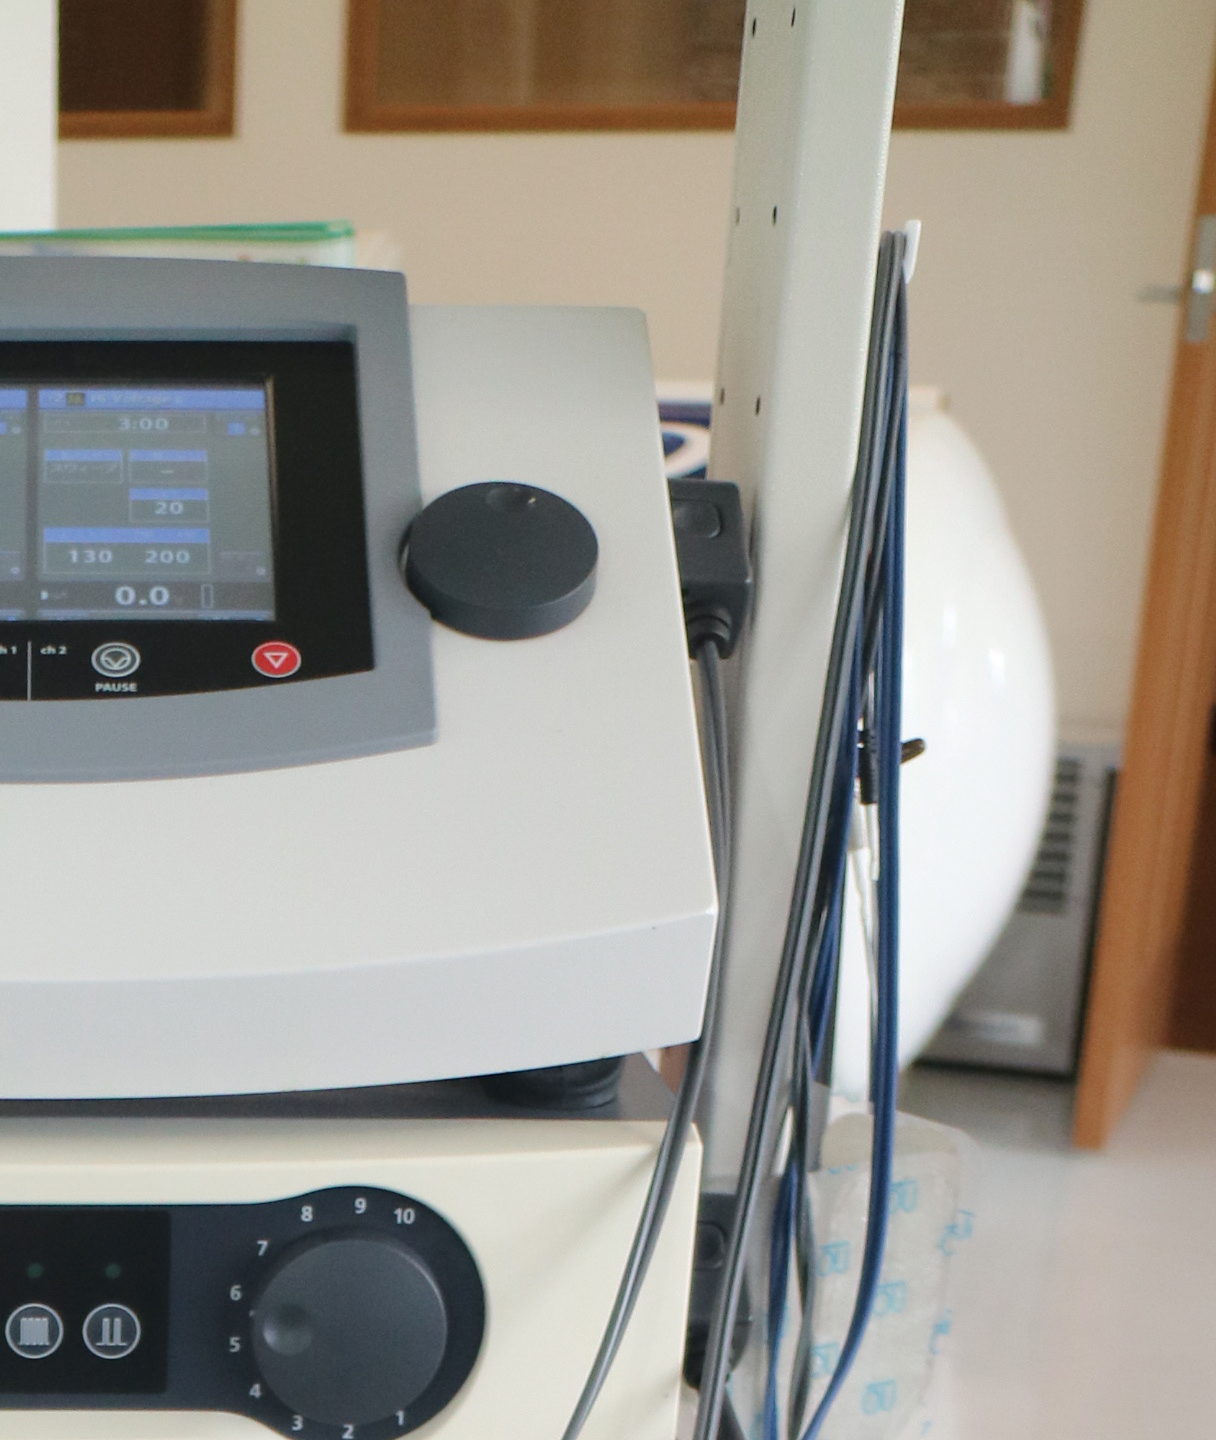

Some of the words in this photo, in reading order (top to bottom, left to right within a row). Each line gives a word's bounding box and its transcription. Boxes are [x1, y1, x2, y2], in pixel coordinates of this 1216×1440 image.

[119, 417, 169, 431] 3:00
[154, 501, 183, 515] 20
[69, 550, 113, 564] 130
[144, 550, 190, 564] 200
[115, 586, 170, 605] 0.0
[40, 645, 56, 655] ch
[58, 646, 67, 655] 2
[95, 683, 137, 693] PAUSE
[354, 1198, 367, 1214] 9
[300, 1206, 313, 1222] 8
[393, 1208, 416, 1224] 10
[257, 1240, 269, 1256] 7
[230, 1284, 242, 1301] 6
[229, 1336, 241, 1352] 5
[249, 1383, 261, 1398] 4
[292, 1415, 304, 1431] 3
[396, 1410, 405, 1425] 1
[342, 1424, 354, 1439] 2
